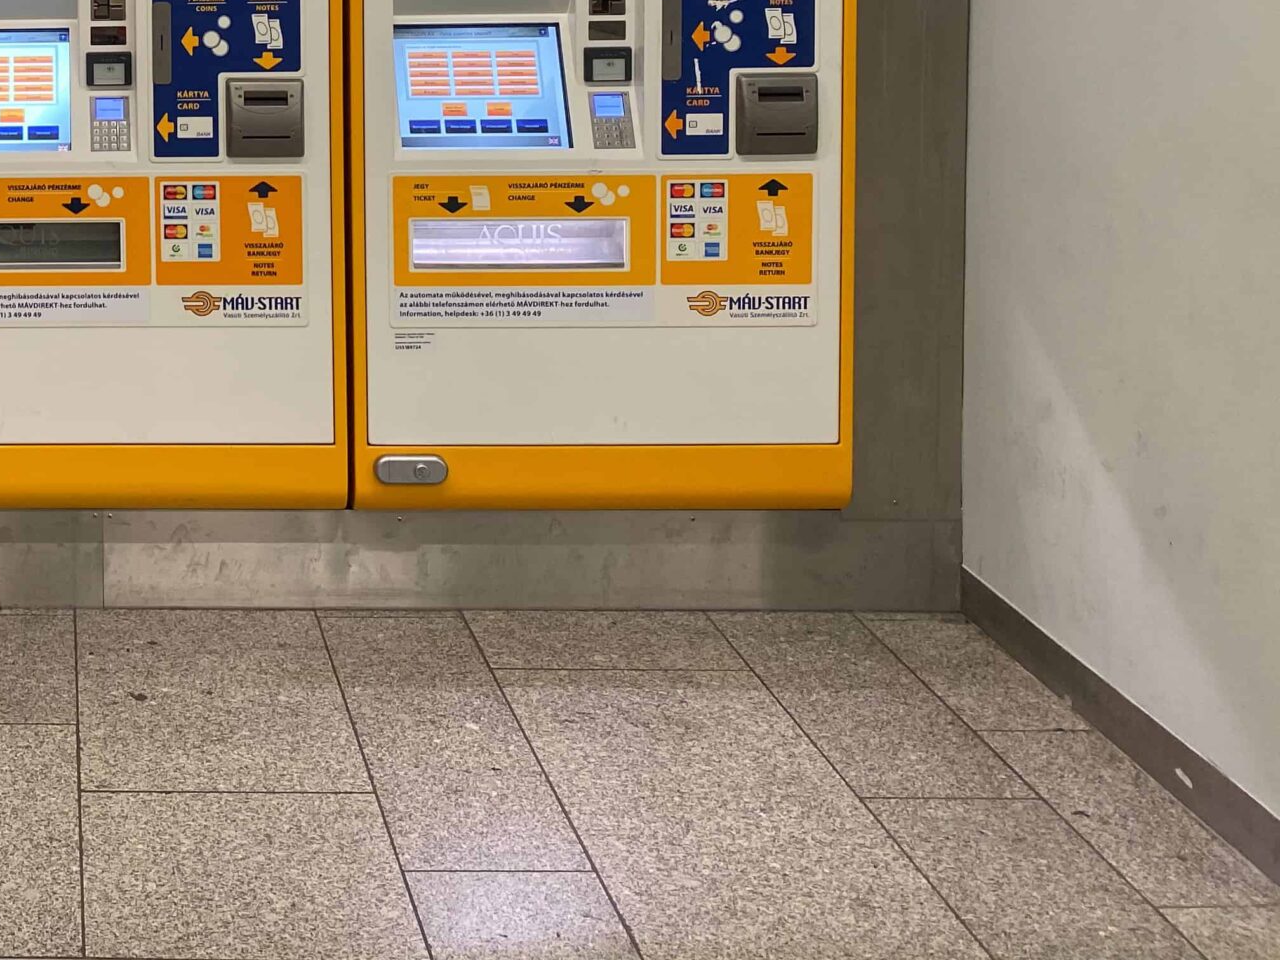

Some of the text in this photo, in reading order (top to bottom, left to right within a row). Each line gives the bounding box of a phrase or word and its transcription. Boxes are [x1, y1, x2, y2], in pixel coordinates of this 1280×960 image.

[176, 90, 209, 98] KÁRTYA
[673, 204, 694, 212] VISA
[222, 293, 302, 310] MÁV-START
[728, 292, 810, 310] MÁV-START
